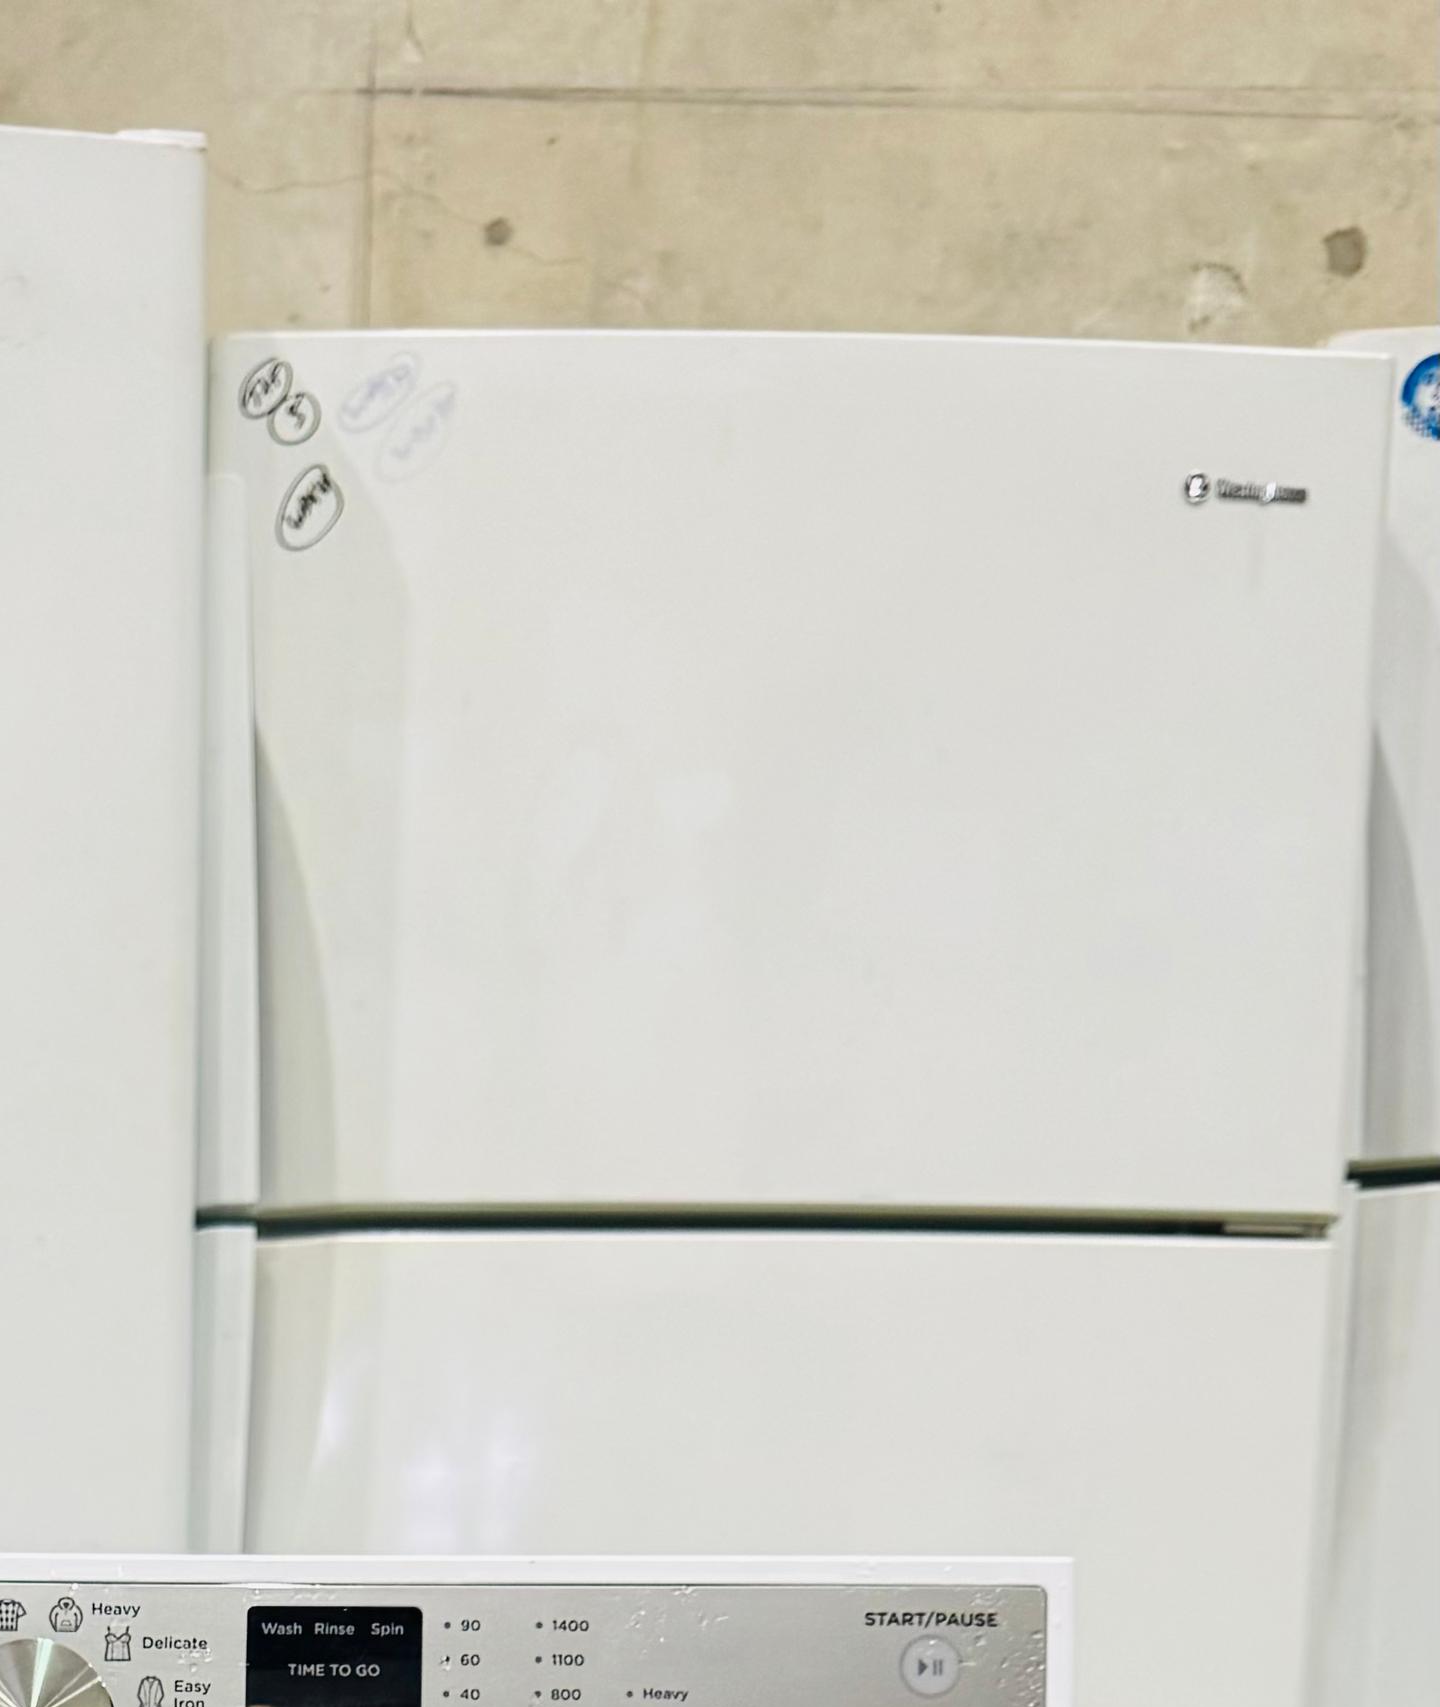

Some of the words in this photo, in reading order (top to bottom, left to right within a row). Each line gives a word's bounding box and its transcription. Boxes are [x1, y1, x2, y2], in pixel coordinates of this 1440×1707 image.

[92, 1603, 140, 1617] Heavy
[461, 1620, 480, 1631] 90
[553, 1620, 589, 1632] 1400
[865, 1612, 998, 1628] START/PAUSE
[262, 1623, 302, 1635] Wash
[315, 1623, 354, 1635] Rinse
[371, 1623, 403, 1636] Spin
[143, 1637, 207, 1649] Delicate
[461, 1654, 480, 1666] 60
[552, 1654, 584, 1666] 1100
[288, 1664, 325, 1676] TIME
[329, 1664, 351, 1676] TO
[356, 1664, 380, 1676] GO
[175, 1680, 211, 1695] Easy
[460, 1689, 480, 1700] 40
[551, 1689, 581, 1700] 800
[643, 1688, 688, 1701] Heavy
